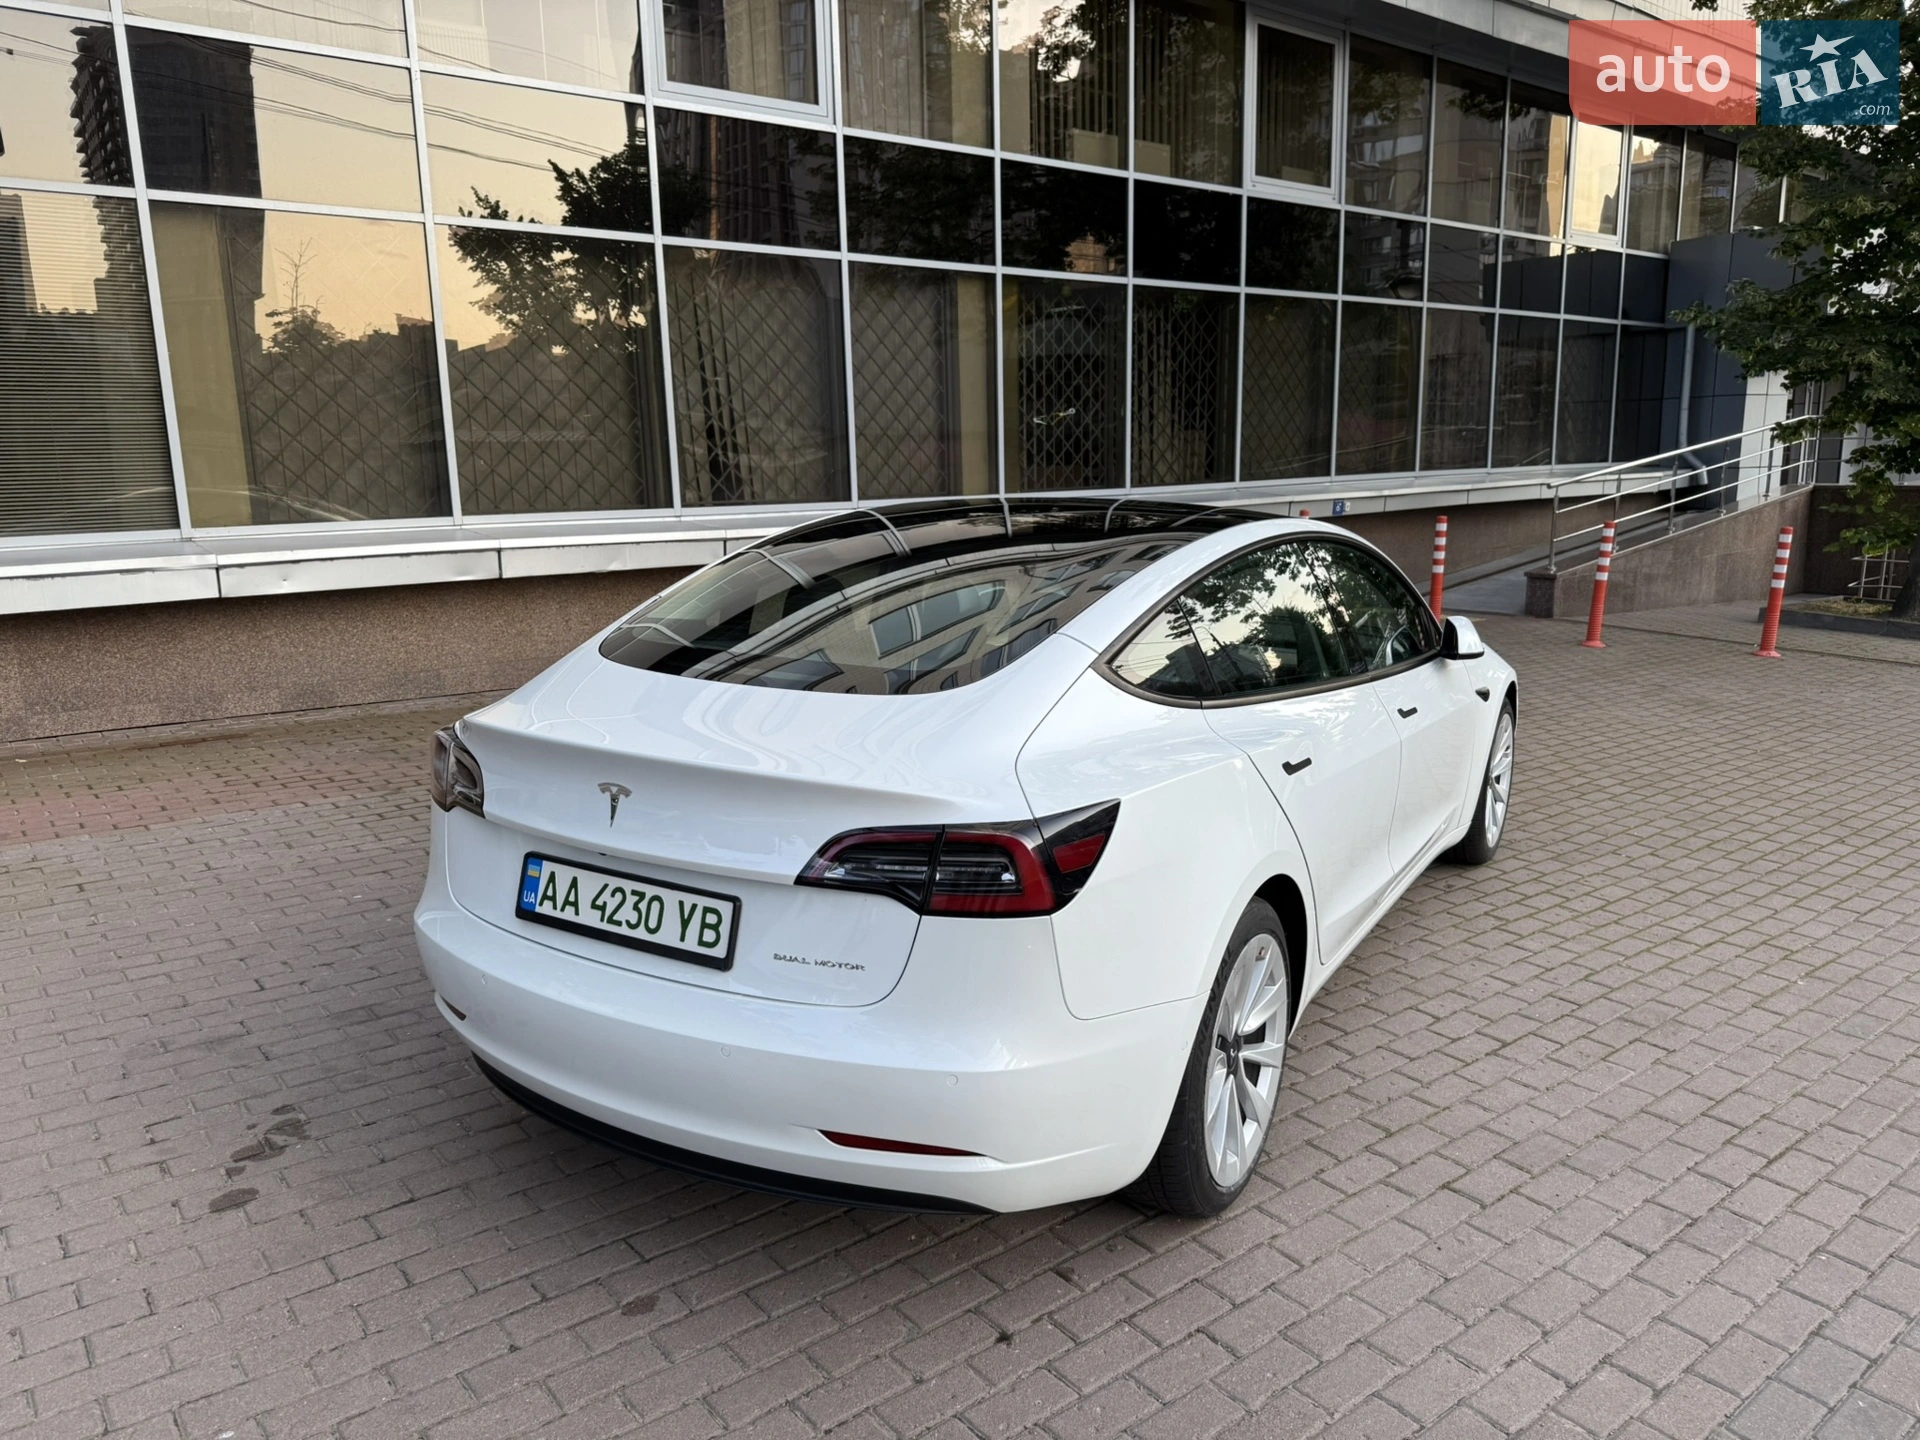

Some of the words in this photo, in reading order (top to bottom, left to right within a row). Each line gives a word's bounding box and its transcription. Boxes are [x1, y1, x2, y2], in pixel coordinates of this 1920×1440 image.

[523, 891, 536, 905] UA
[538, 870, 580, 917] AA
[590, 883, 665, 935] 4230
[678, 899, 723, 949] YB
[773, 952, 811, 965] DUAL
[814, 958, 866, 972] MOTOR
